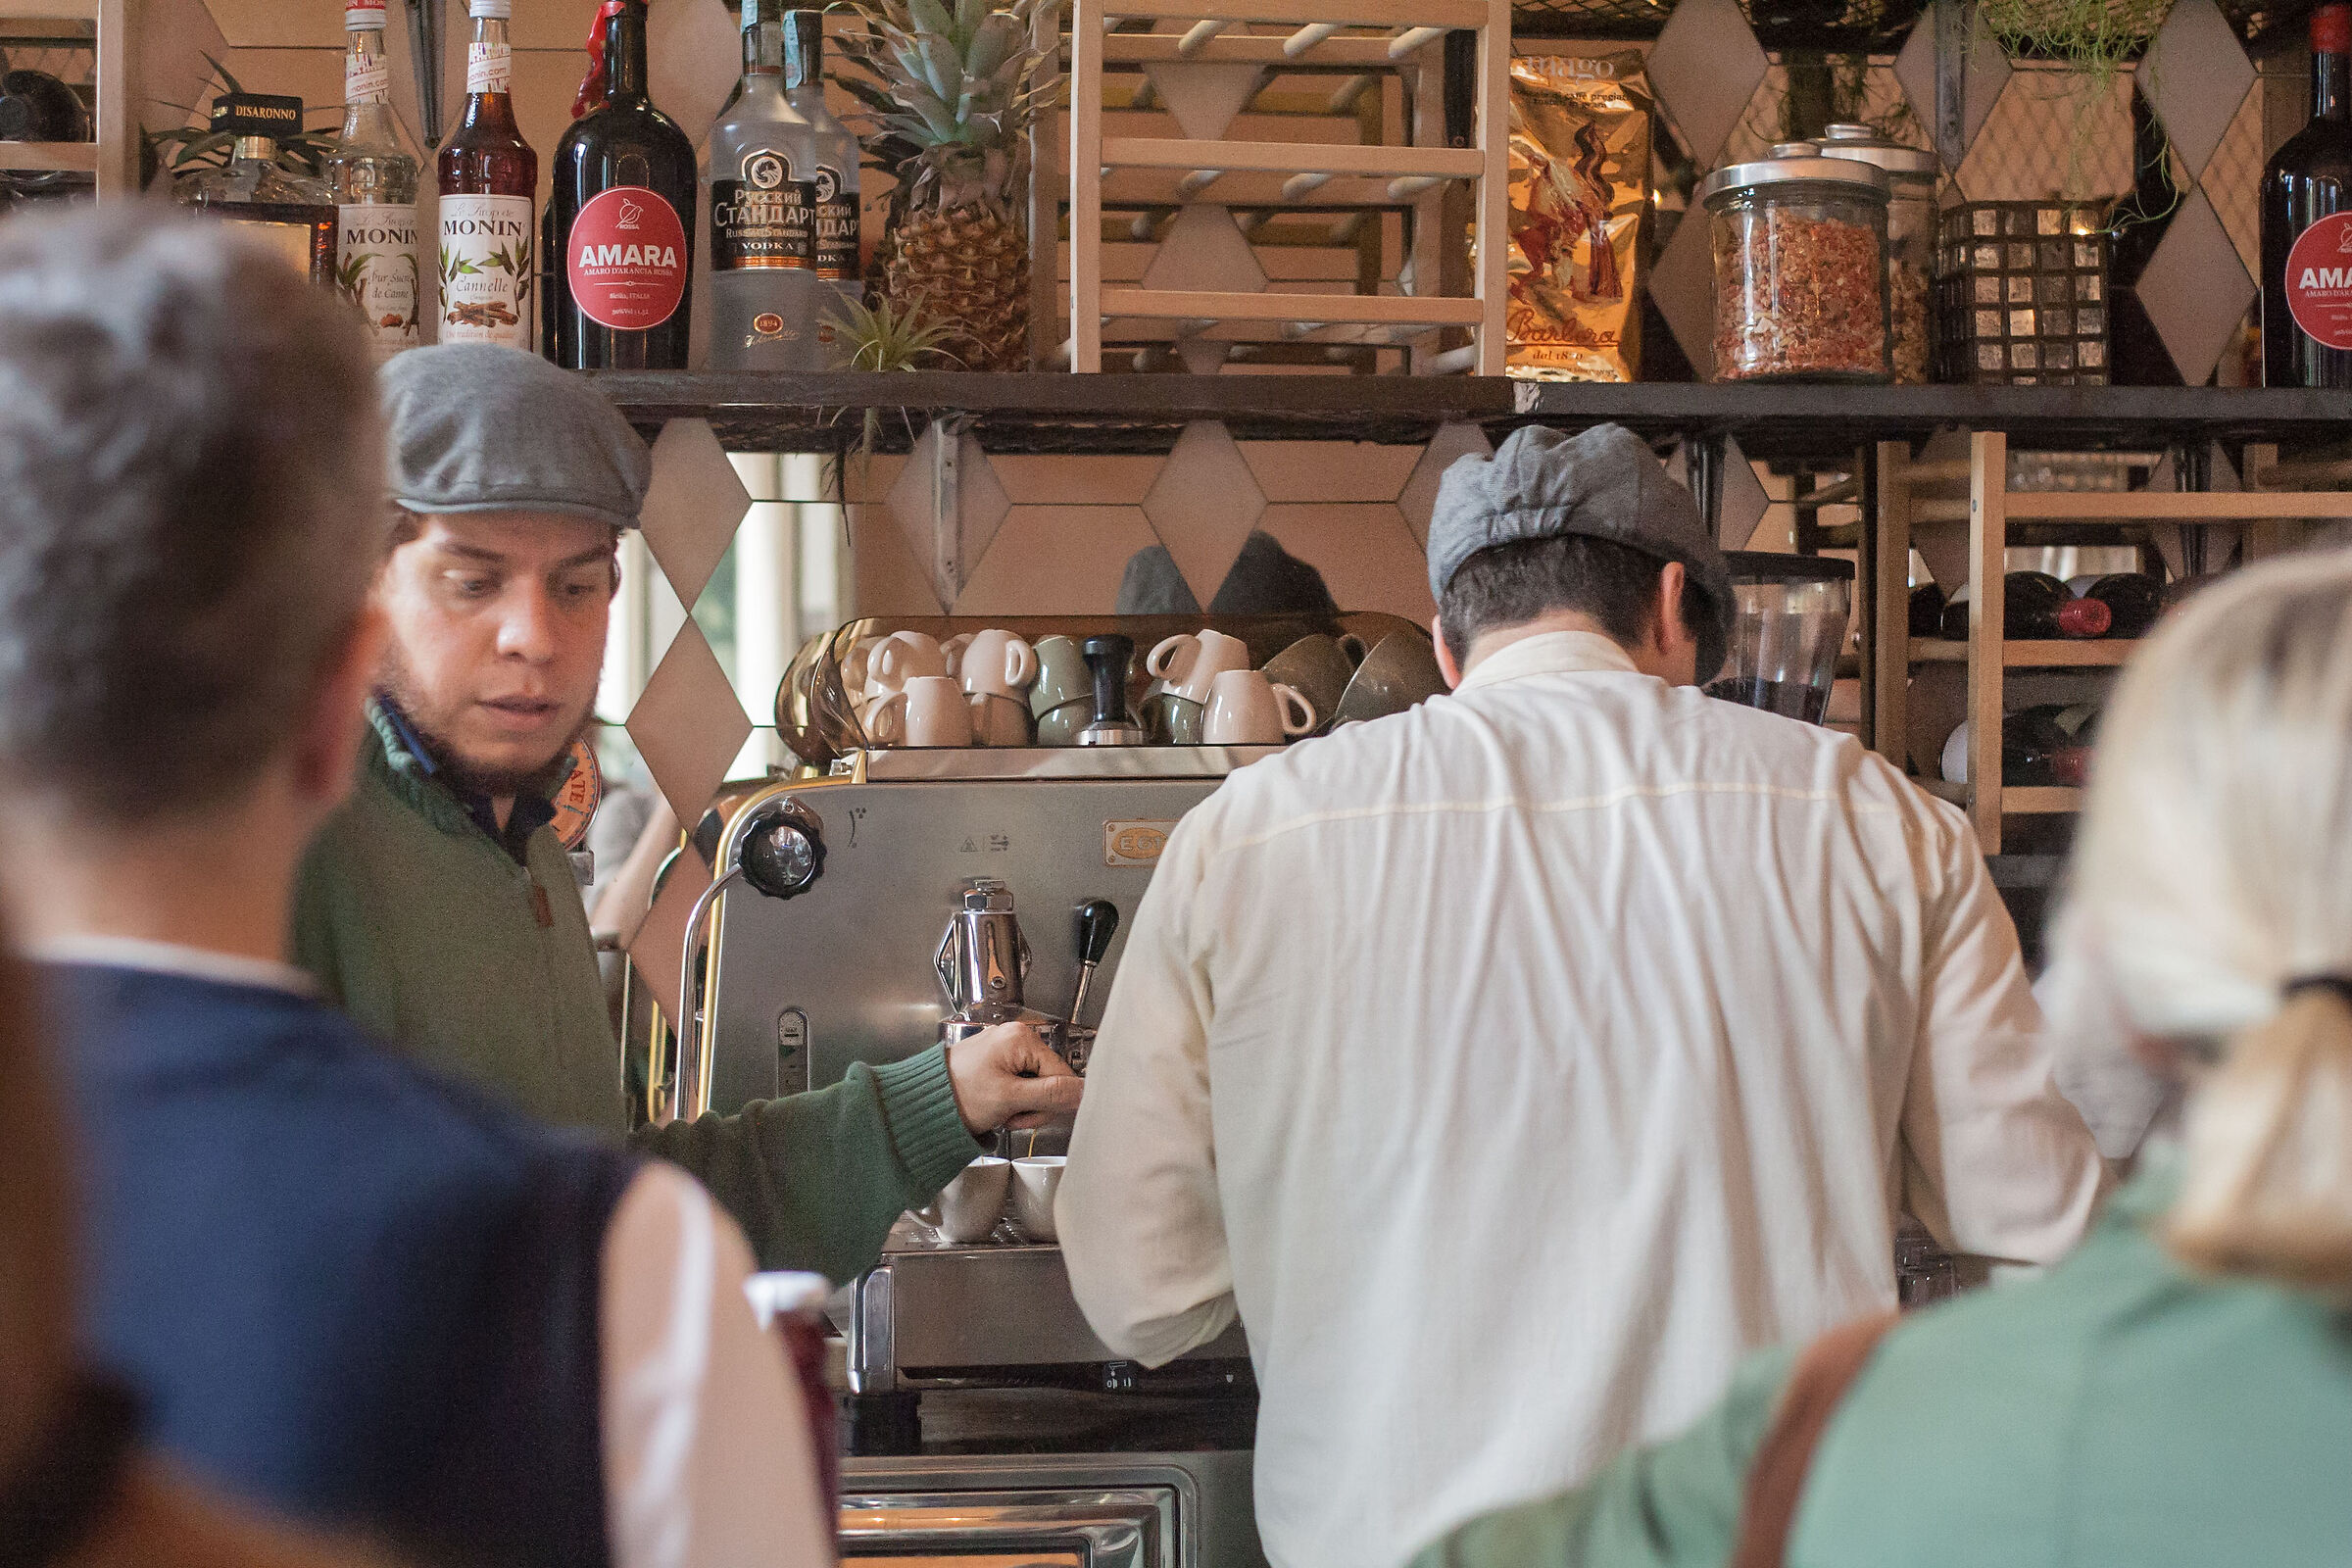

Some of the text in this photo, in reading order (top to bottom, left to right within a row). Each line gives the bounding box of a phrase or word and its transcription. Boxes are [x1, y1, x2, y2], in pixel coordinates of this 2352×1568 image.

[468, 67, 507, 81] onin.com
[235, 105, 297, 121] DISARONNO
[714, 202, 815, 226] СТАНДАРТ
[444, 219, 522, 236] MONIN
[578, 244, 677, 268] AMARA
[456, 275, 509, 292] Cannelle
[1533, 351, 1583, 361] dal 180
